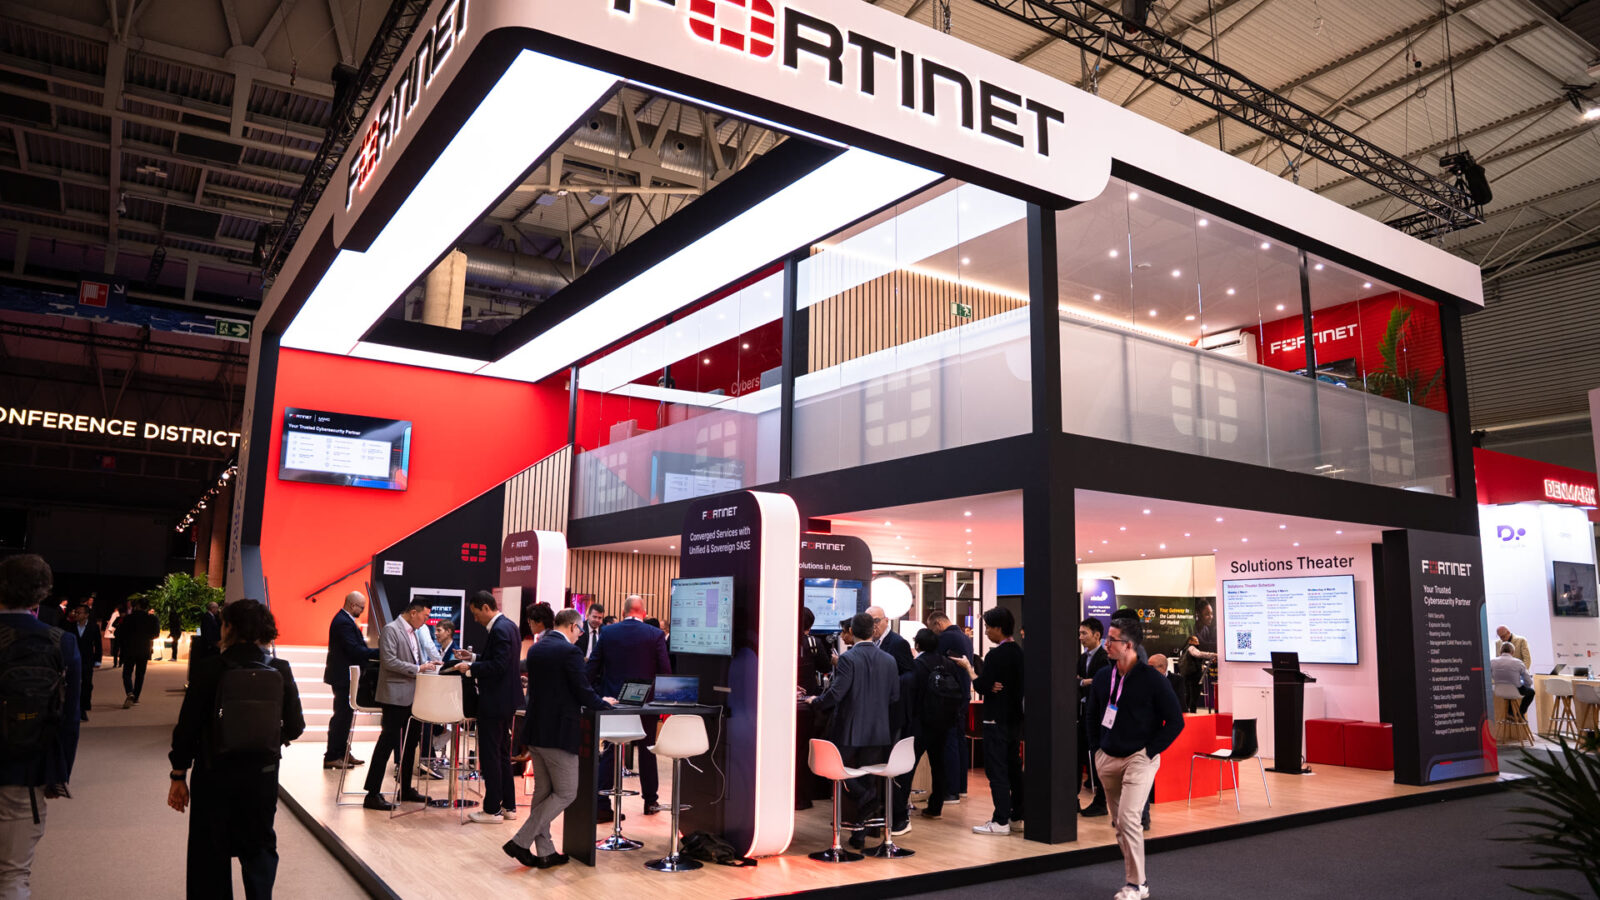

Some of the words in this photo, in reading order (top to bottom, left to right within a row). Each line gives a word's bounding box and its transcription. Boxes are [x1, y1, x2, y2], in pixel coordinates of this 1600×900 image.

[614, 0, 1064, 157] ORTINET
[144, 422, 241, 448] DISTRICT
[316, 426, 345, 435] Cybersecurity
[1544, 479, 1596, 505] DENMARK
[702, 506, 738, 520] FORTINET
[690, 530, 716, 542] Converged
[716, 528, 738, 539] Services
[739, 526, 750, 535] with
[688, 545, 705, 555] Unified
[706, 546, 710, 554] &
[711, 542, 735, 554] Sovereign
[736, 540, 750, 550] SASE
[801, 541, 845, 551] FORTINET
[1231, 559, 1293, 573] Solutions
[1297, 556, 1354, 569] Theater
[1422, 560, 1472, 576] FORTINET
[1434, 586, 1451, 594] Trusted
[1424, 597, 1454, 607] Cybersecurity
[1136, 609, 1156, 618] GC26
